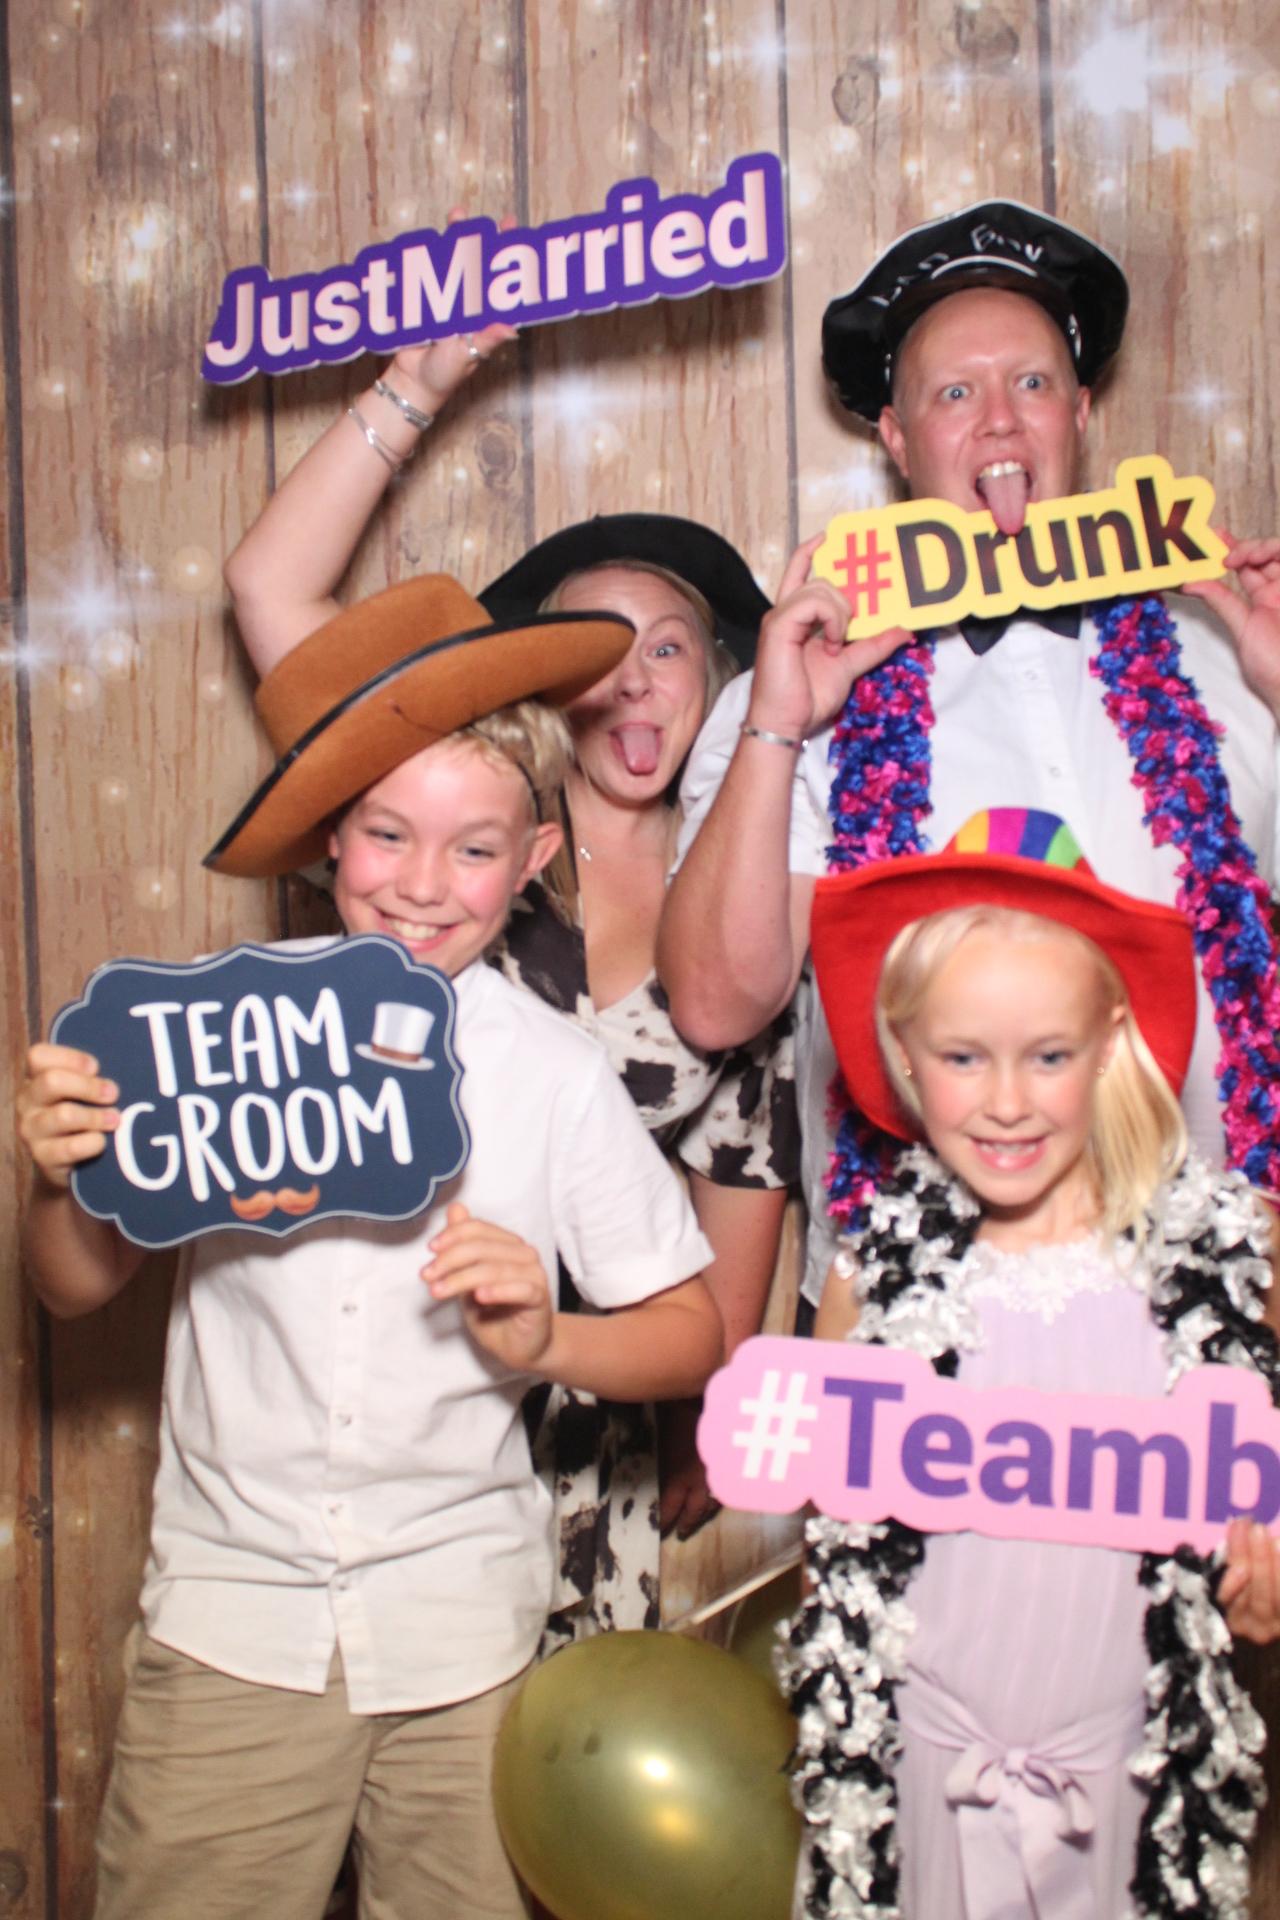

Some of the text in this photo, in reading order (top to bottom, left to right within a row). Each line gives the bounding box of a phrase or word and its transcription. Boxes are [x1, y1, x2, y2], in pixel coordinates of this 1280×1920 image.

[833, 476, 1210, 618] #Drunk
[129, 987, 351, 1098] TEAM
[114, 1076, 413, 1202] GROOM
[732, 1368, 1280, 1526] #Teamb
